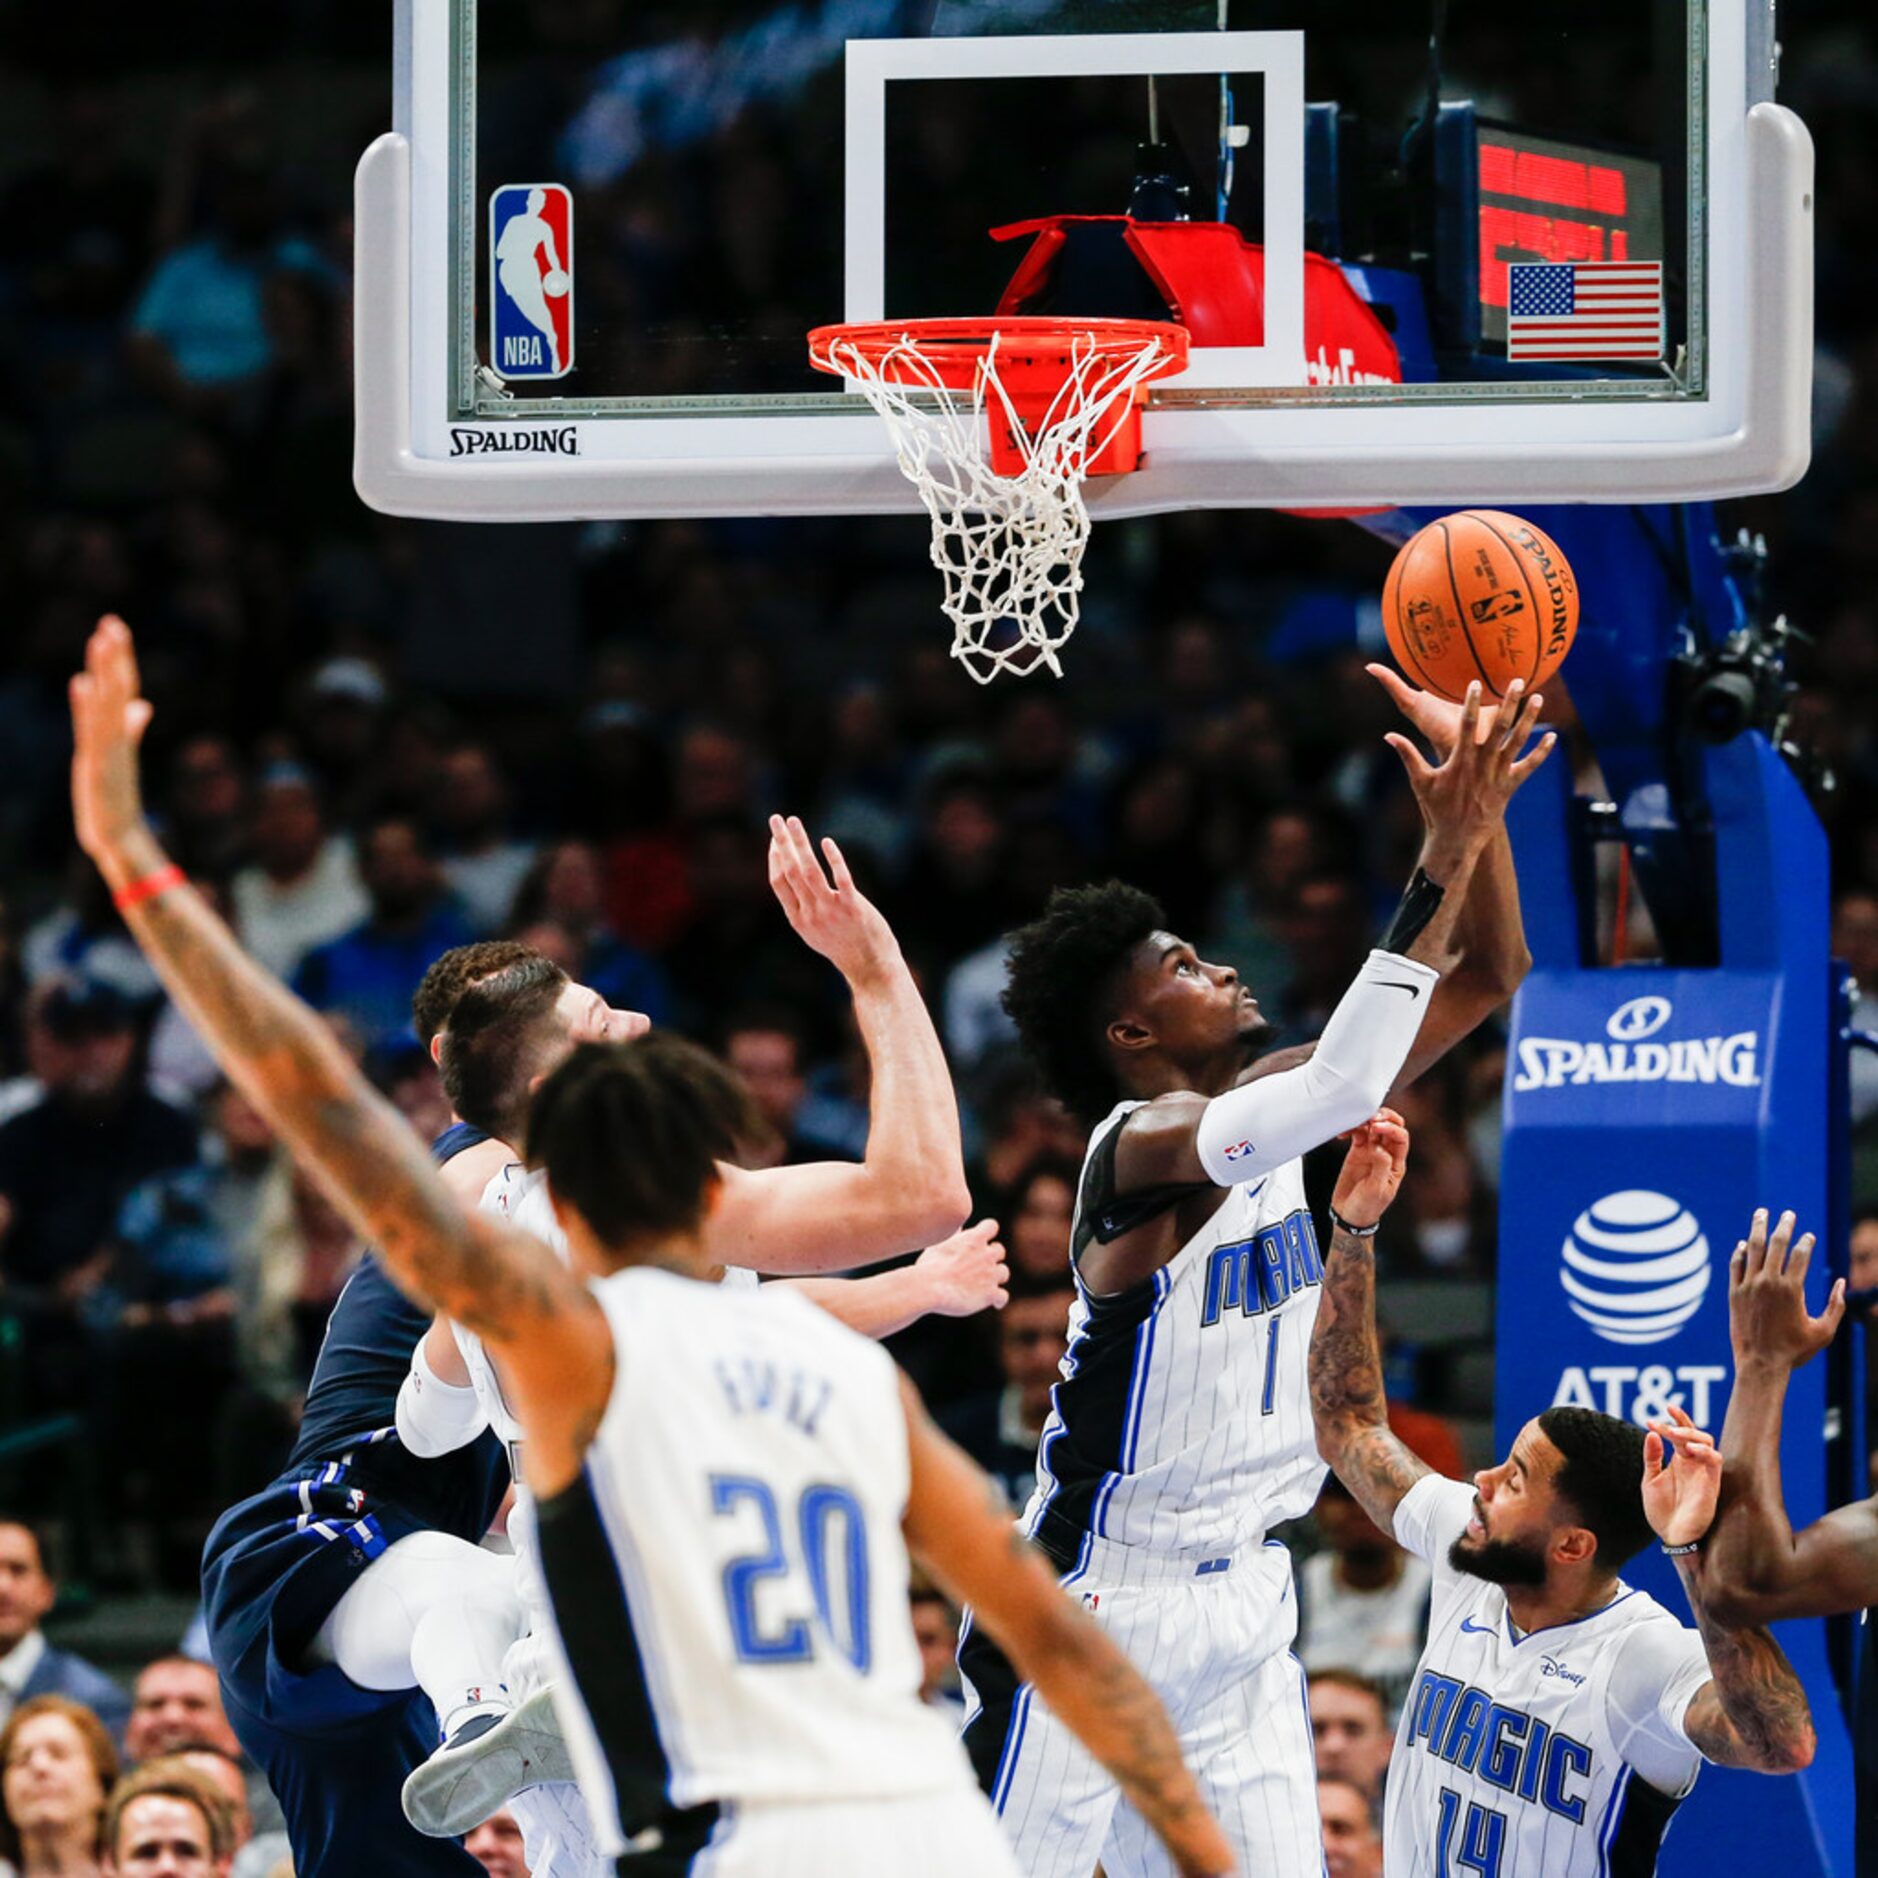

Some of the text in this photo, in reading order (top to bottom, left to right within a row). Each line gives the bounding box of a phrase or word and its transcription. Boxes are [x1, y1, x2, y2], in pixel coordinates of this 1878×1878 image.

[503, 335, 543, 367] NBA
[450, 426, 578, 457] SPALDING
[1508, 527, 1568, 657] SPALDING
[1514, 1031, 1761, 1092] SPALDING
[1261, 1313, 1282, 1416] 1
[1551, 1364, 1727, 1432] AT&T
[706, 1470, 873, 1677] 20
[1540, 1655, 1588, 1689] Disney
[1407, 1668, 1593, 1826] MAGIC
[1435, 1785, 1508, 1878] 14
